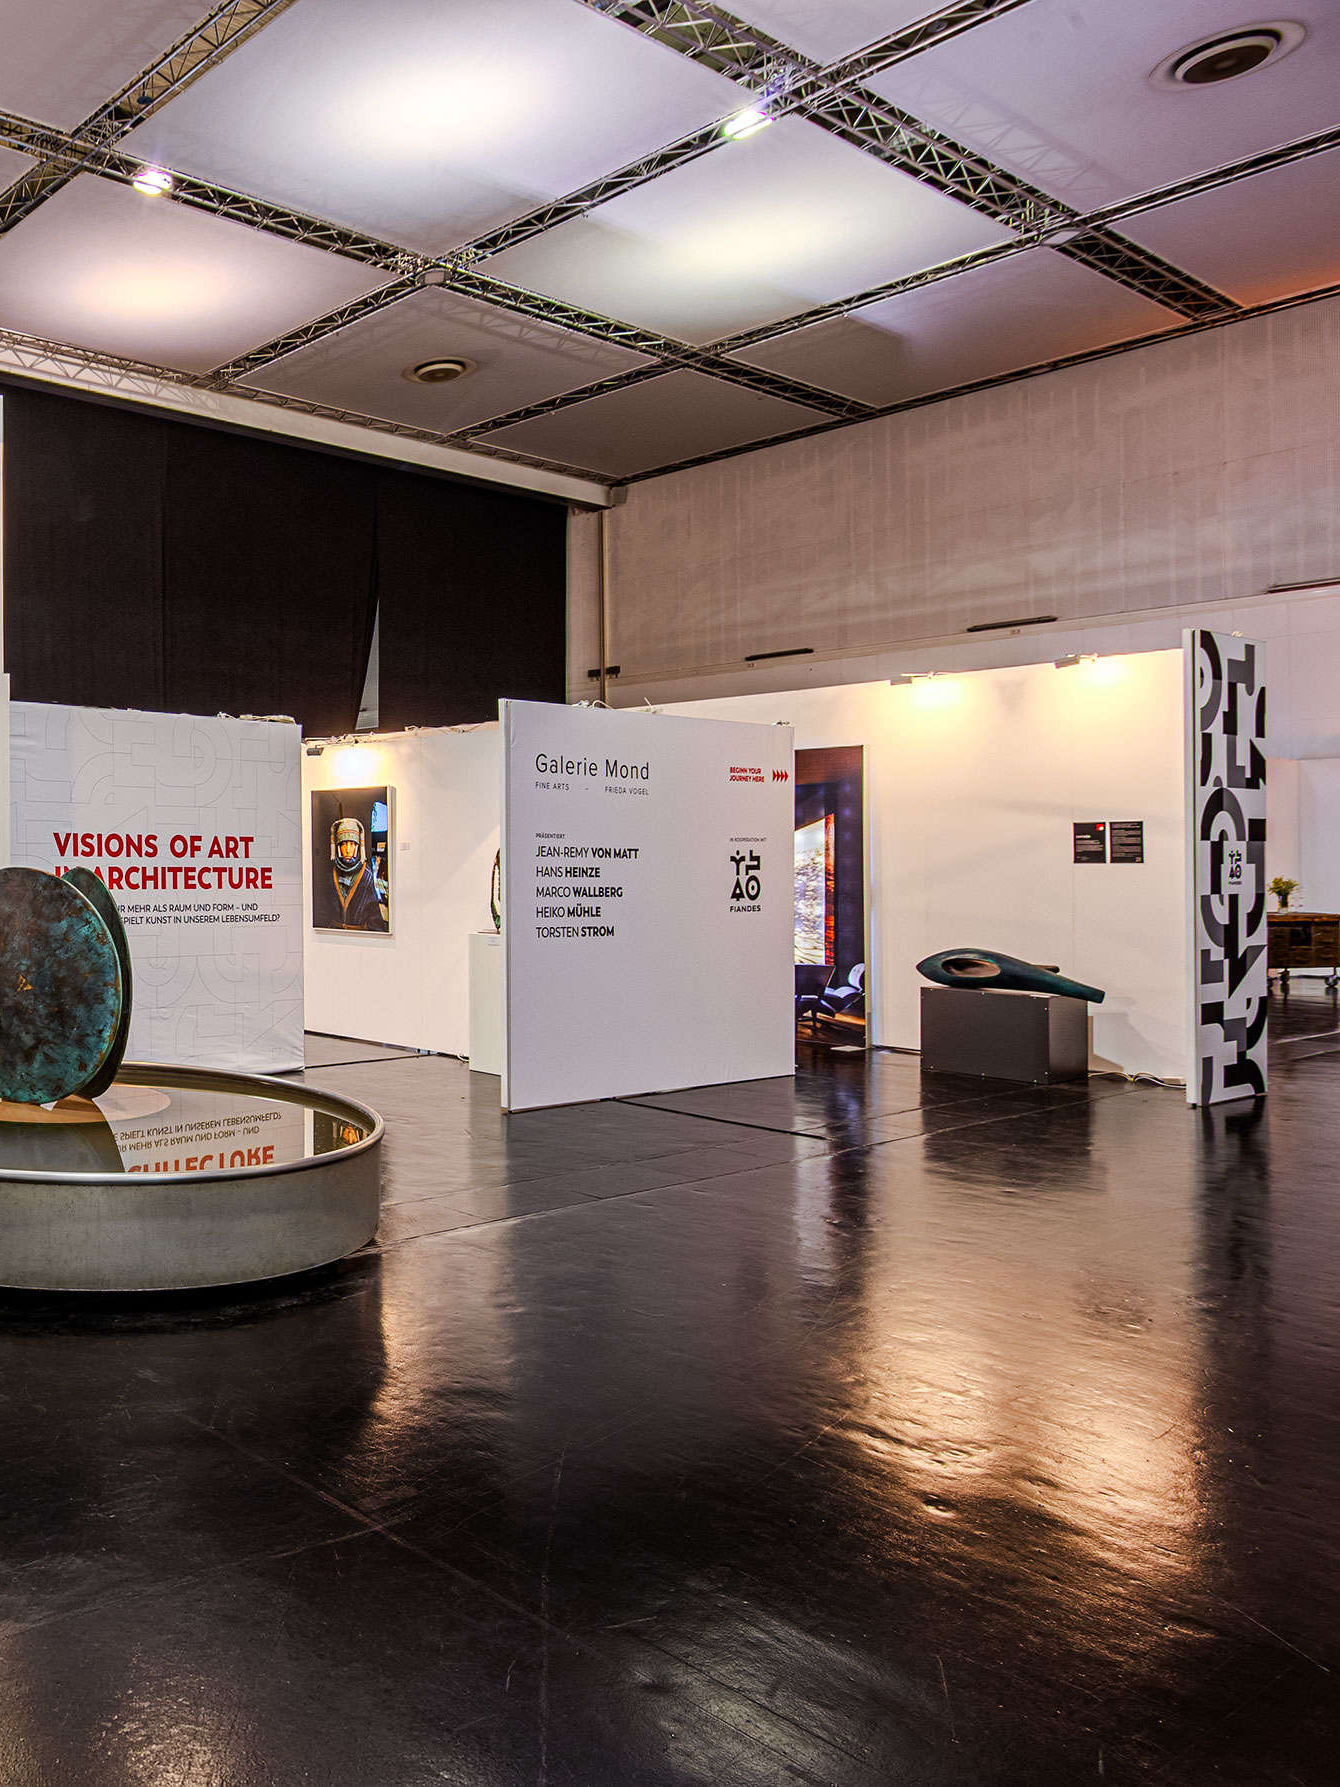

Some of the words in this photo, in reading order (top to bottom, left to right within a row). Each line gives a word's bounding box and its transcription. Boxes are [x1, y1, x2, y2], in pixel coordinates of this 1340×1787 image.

[535, 753, 598, 777] Galerie
[605, 758, 650, 780] Mond
[535, 781, 550, 790] FINE
[553, 782, 570, 791] ARTS
[604, 786, 627, 794] FRIEDA
[629, 787, 649, 796] VOGEL
[53, 832, 158, 858] VISIONS
[169, 834, 203, 858] OF
[208, 836, 254, 859] ART
[535, 845, 590, 858] JEAN-REMY
[591, 847, 612, 859] VON
[613, 848, 639, 859] MATT
[536, 866, 563, 877] HANS
[565, 867, 601, 878] HEINZE
[535, 886, 571, 898] MARCO
[572, 886, 623, 898] WALLBERG
[127, 904, 151, 913] MEHR
[152, 904, 167, 913] ALS
[169, 904, 192, 913] RAUM
[193, 903, 211, 912] UND
[212, 903, 234, 912] FORM
[241, 902, 259, 911] UND
[536, 906, 566, 918] HEIKO
[567, 903, 602, 918] MÜHLE
[729, 905, 761, 913] FIANDES
[145, 915, 172, 925] KUNST
[173, 915, 182, 924] IN
[183, 914, 220, 924] UNSEREM
[221, 913, 281, 924] LEBENSUMFELD?
[536, 926, 579, 938] TORSTEN
[580, 926, 615, 937] STROM
